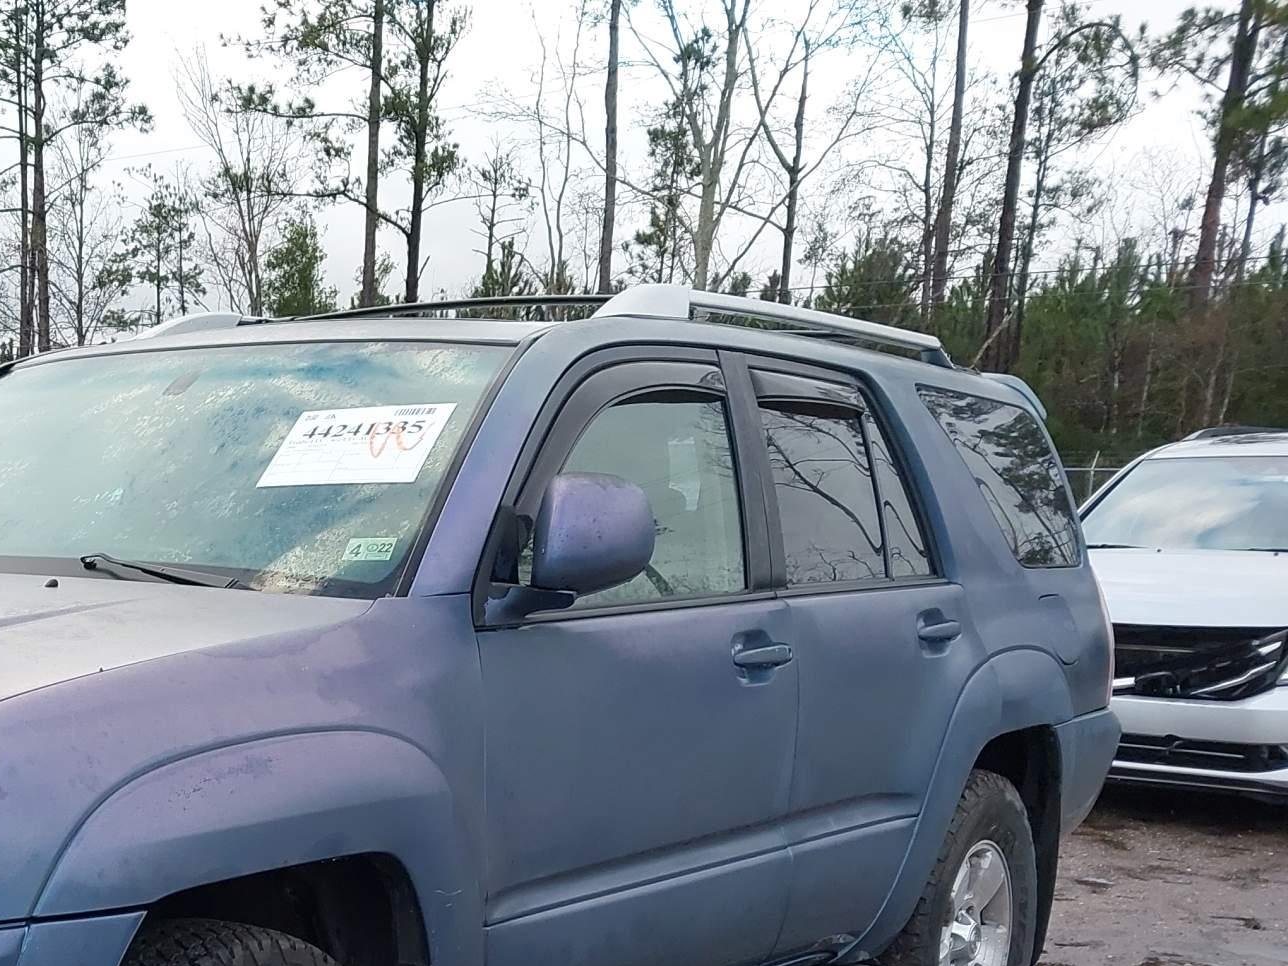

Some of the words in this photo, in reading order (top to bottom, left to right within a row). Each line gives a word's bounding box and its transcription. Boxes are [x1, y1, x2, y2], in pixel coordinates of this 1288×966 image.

[303, 419, 427, 439] 44241335
[349, 543, 362, 557] 4
[377, 542, 394, 553] 22
